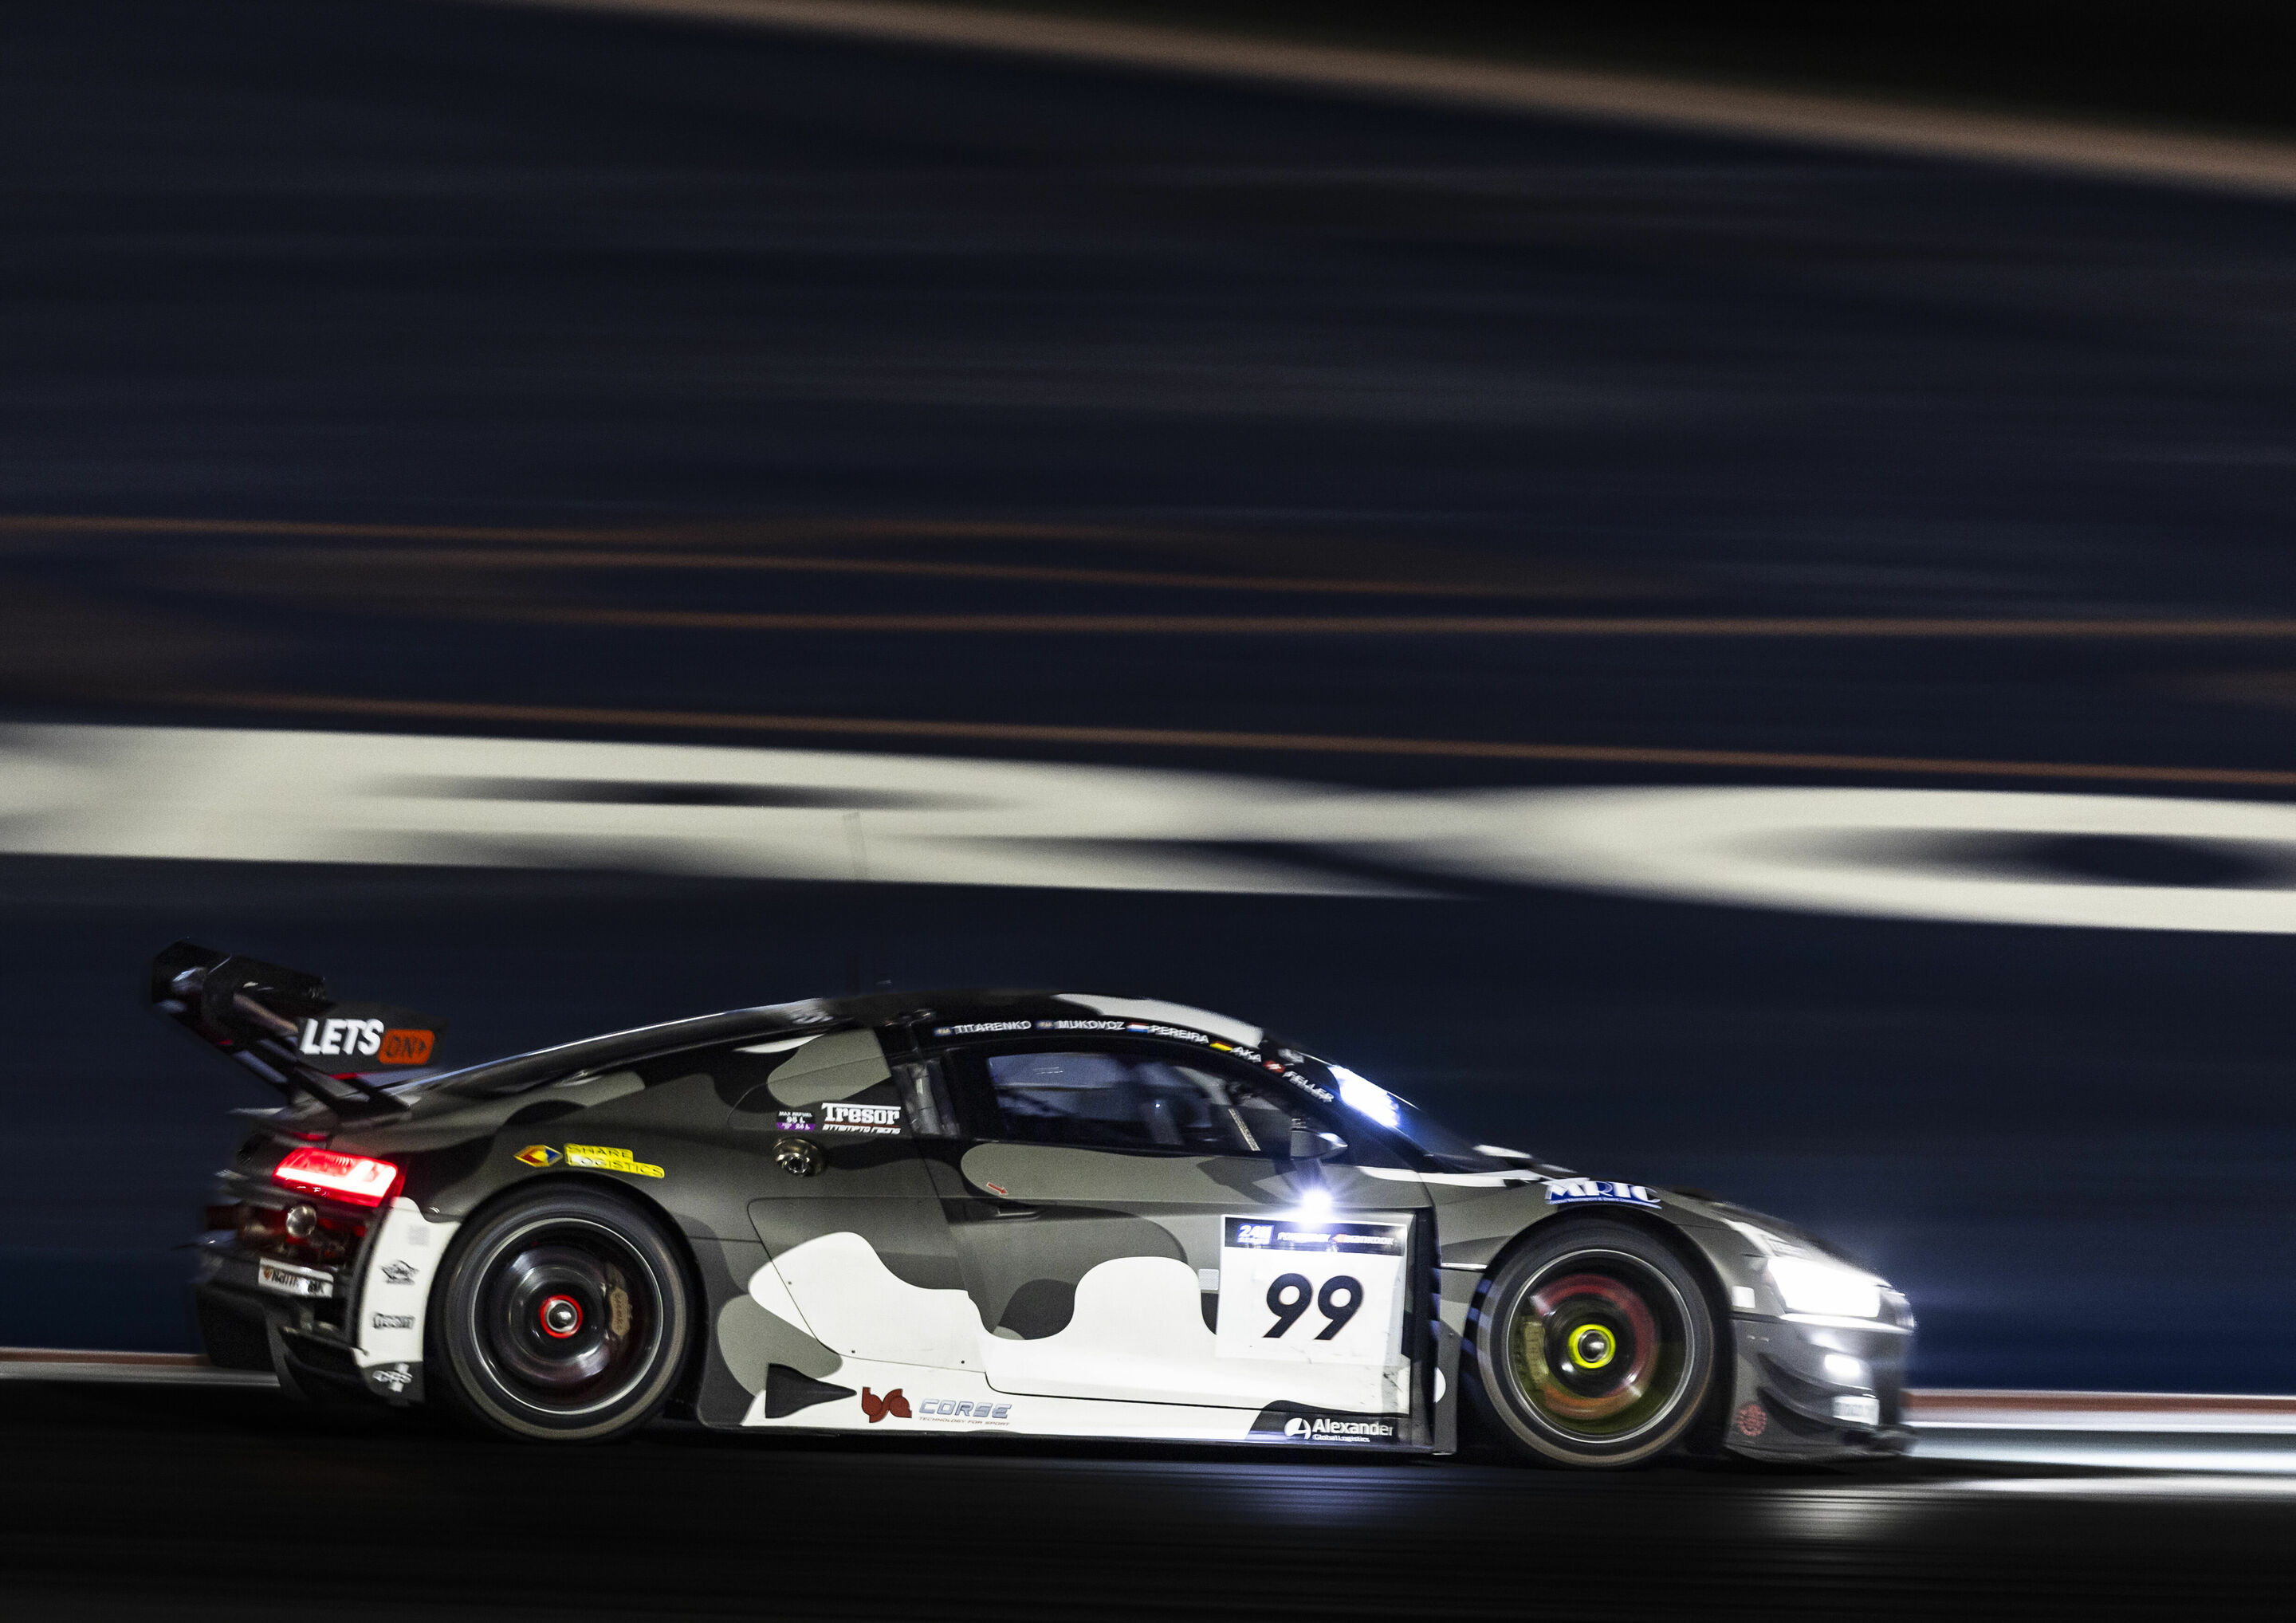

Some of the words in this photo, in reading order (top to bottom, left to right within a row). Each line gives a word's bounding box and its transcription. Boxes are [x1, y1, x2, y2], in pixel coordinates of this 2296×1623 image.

[300, 1018, 384, 1055] LETS
[952, 1020, 1031, 1034] TITARENKO
[1054, 1020, 1126, 1030] MUKOVOZ
[1150, 1025, 1209, 1044] PEREIRA
[1230, 1047, 1262, 1063] AKA
[1283, 1071, 1335, 1102] FELLER
[821, 1102, 901, 1125] Tresor
[567, 1146, 630, 1158] SHARE
[567, 1156, 665, 1177] LOGISTICS
[1262, 1272, 1364, 1340] 99
[919, 1398, 1012, 1419] CORSE
[1312, 1418, 1393, 1436] Alexander
